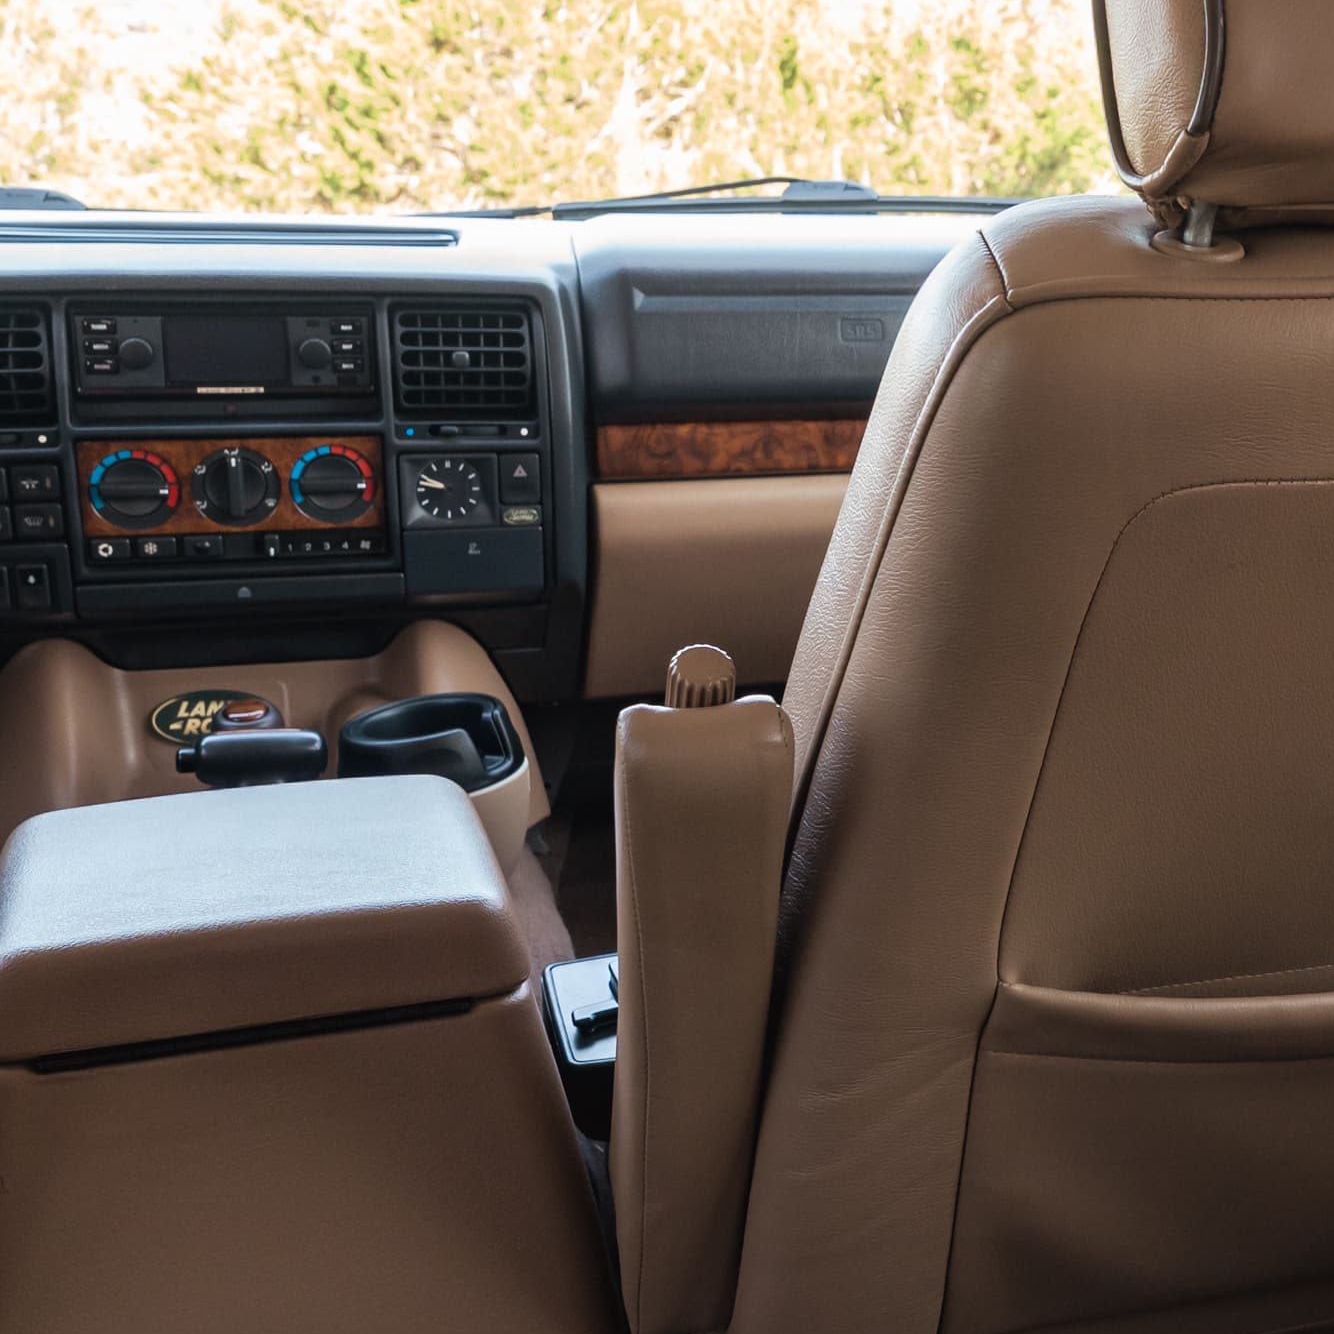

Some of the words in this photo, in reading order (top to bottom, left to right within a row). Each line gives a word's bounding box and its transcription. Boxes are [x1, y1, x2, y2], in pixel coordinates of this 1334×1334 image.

[305, 542, 312, 551] 2
[323, 541, 331, 551] 3
[342, 540, 349, 550] 4
[177, 700, 225, 718] LAN
